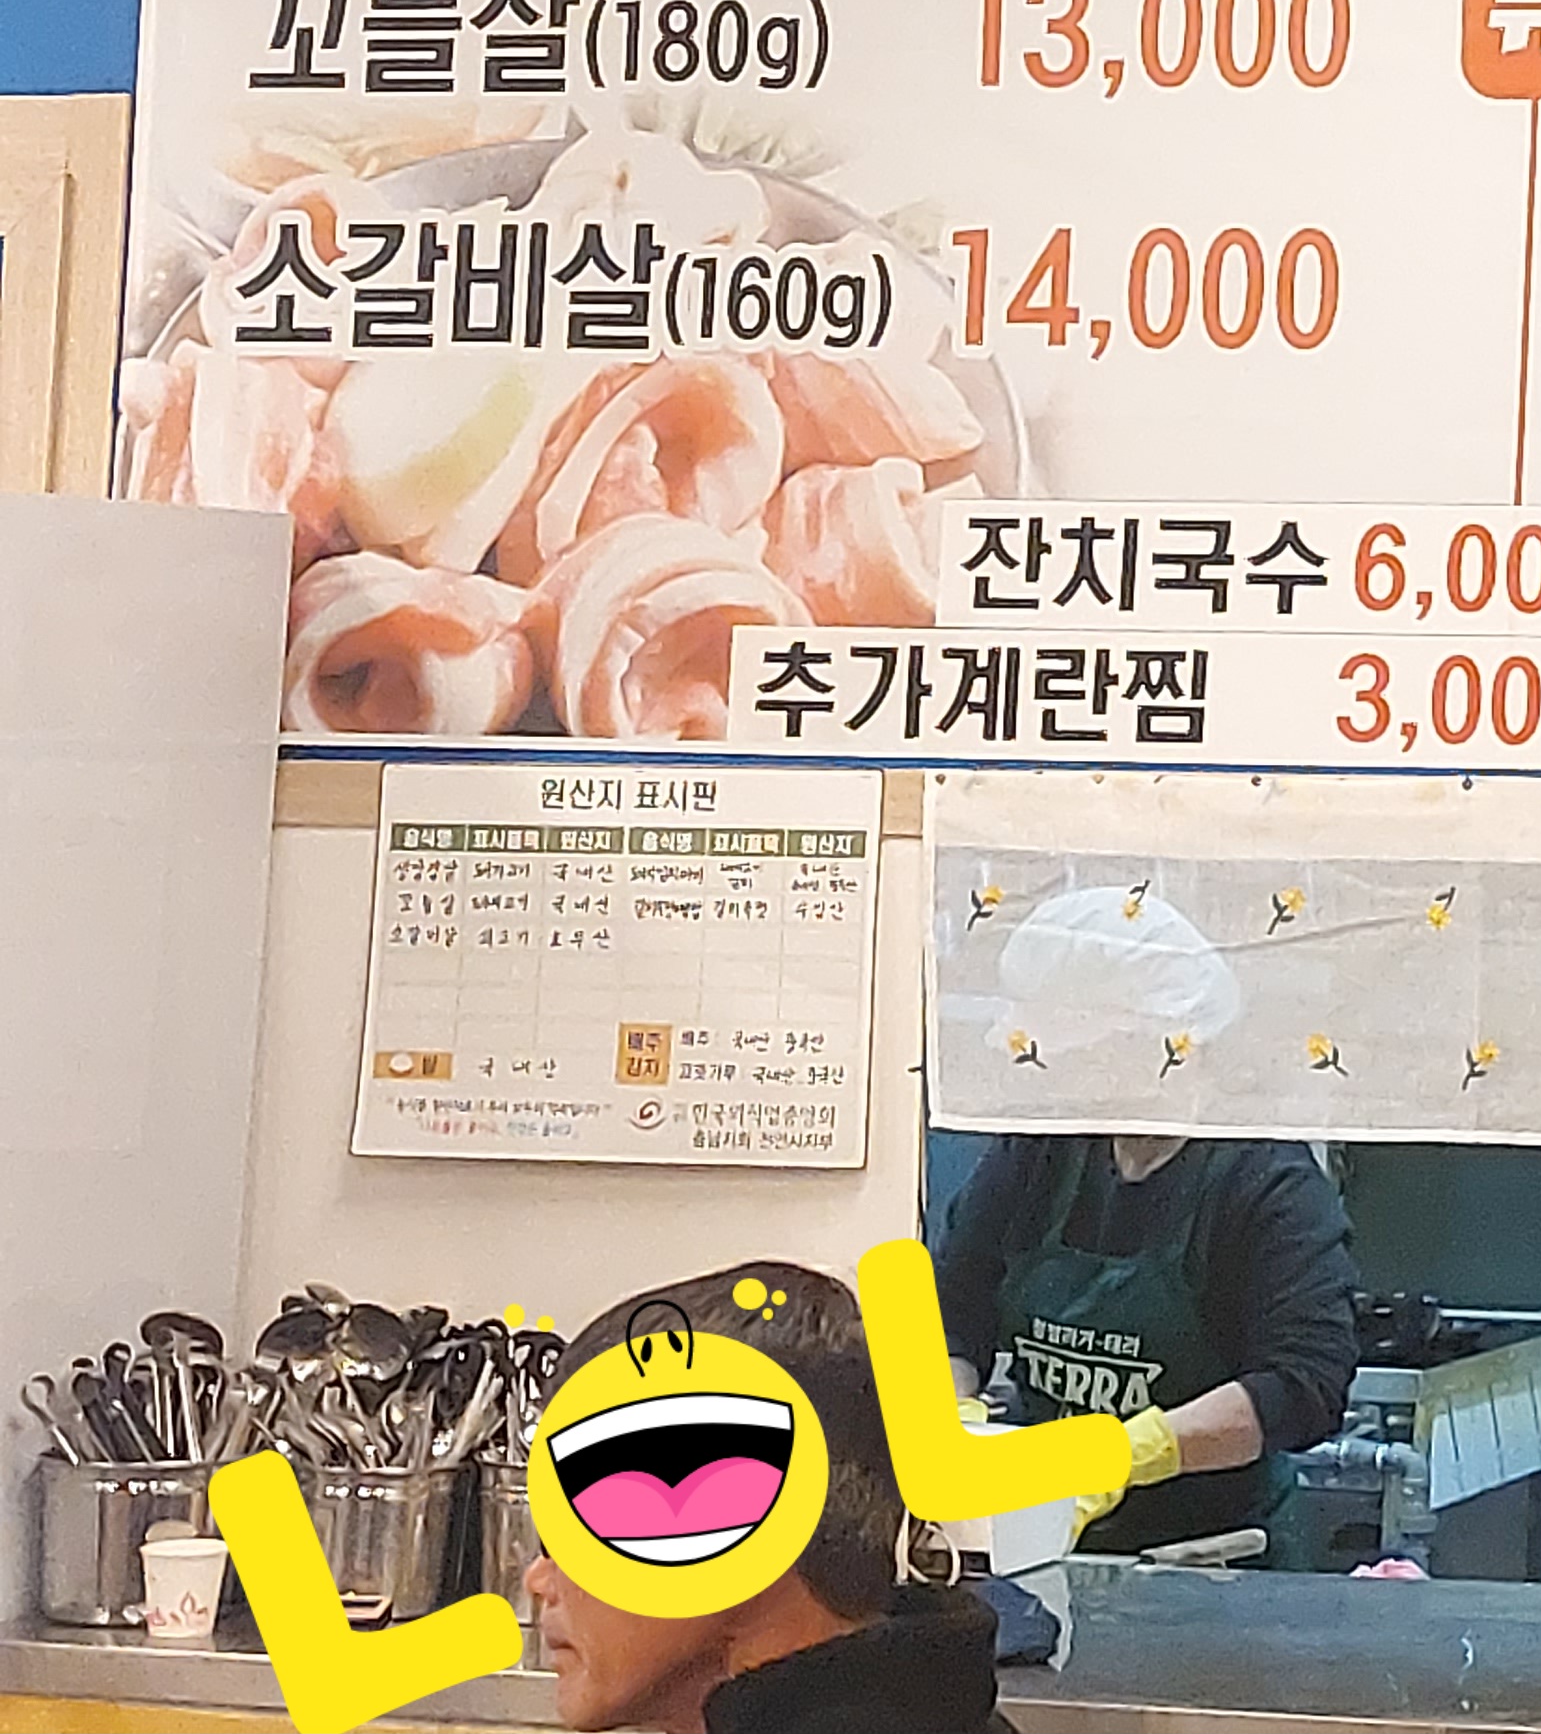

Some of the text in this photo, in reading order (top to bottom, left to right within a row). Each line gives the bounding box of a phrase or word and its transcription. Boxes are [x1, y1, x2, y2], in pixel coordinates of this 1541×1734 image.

[952, 228, 1339, 357] 14,000
[964, 518, 1327, 613] 잔치국수
[756, 646, 1208, 742] 추가계란찜
[540, 778, 718, 813] 원산지 표시판
[1017, 1347, 1152, 1416] TERRA
